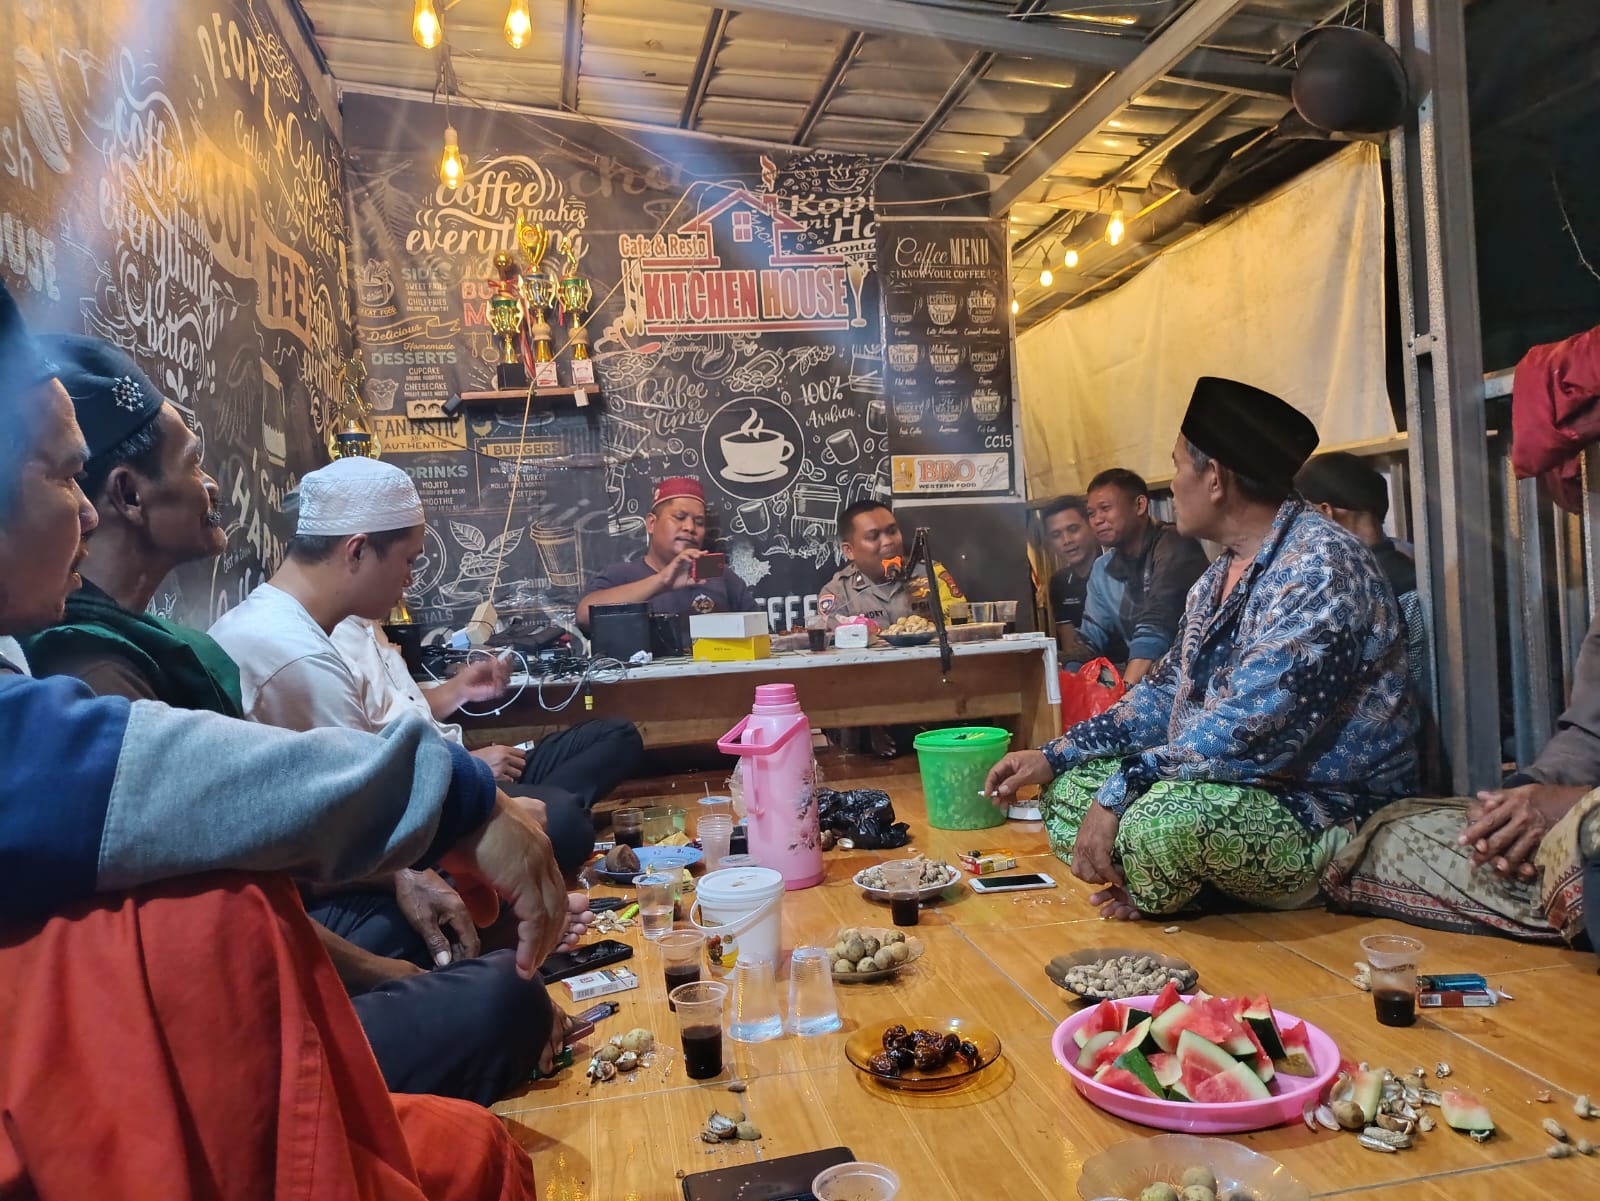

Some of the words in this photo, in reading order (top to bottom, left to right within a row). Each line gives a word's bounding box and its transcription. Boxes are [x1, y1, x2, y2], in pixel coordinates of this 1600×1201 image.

[527, 199, 589, 229] makes
[619, 233, 651, 257] Cafe
[654, 234, 667, 257] &
[669, 234, 707, 257] Resto
[895, 236, 948, 274] Coffee
[950, 238, 989, 265] MENU
[901, 270, 926, 279] KNOW
[929, 268, 951, 279] YOUR
[953, 269, 986, 279] COFFEE
[643, 269, 758, 321] KITCHEN
[760, 267, 849, 319] HOUSE
[367, 322, 422, 341] Delicious
[403, 342, 455, 351] Homemade
[371, 351, 457, 366] DESSERTS
[408, 367, 440, 376] CUPCAKE
[404, 382, 447, 391] CHEESECAKE
[637, 375, 709, 409] Coffee
[799, 374, 844, 406] 100%
[804, 404, 856, 429] Arabica
[384, 441, 448, 450] AUTHENTIC
[493, 442, 560, 456] BURGERS
[984, 434, 1013, 448] CC15
[405, 464, 469, 480] DRINKS
[918, 458, 976, 482] BRO
[422, 481, 449, 490] MOJITO
